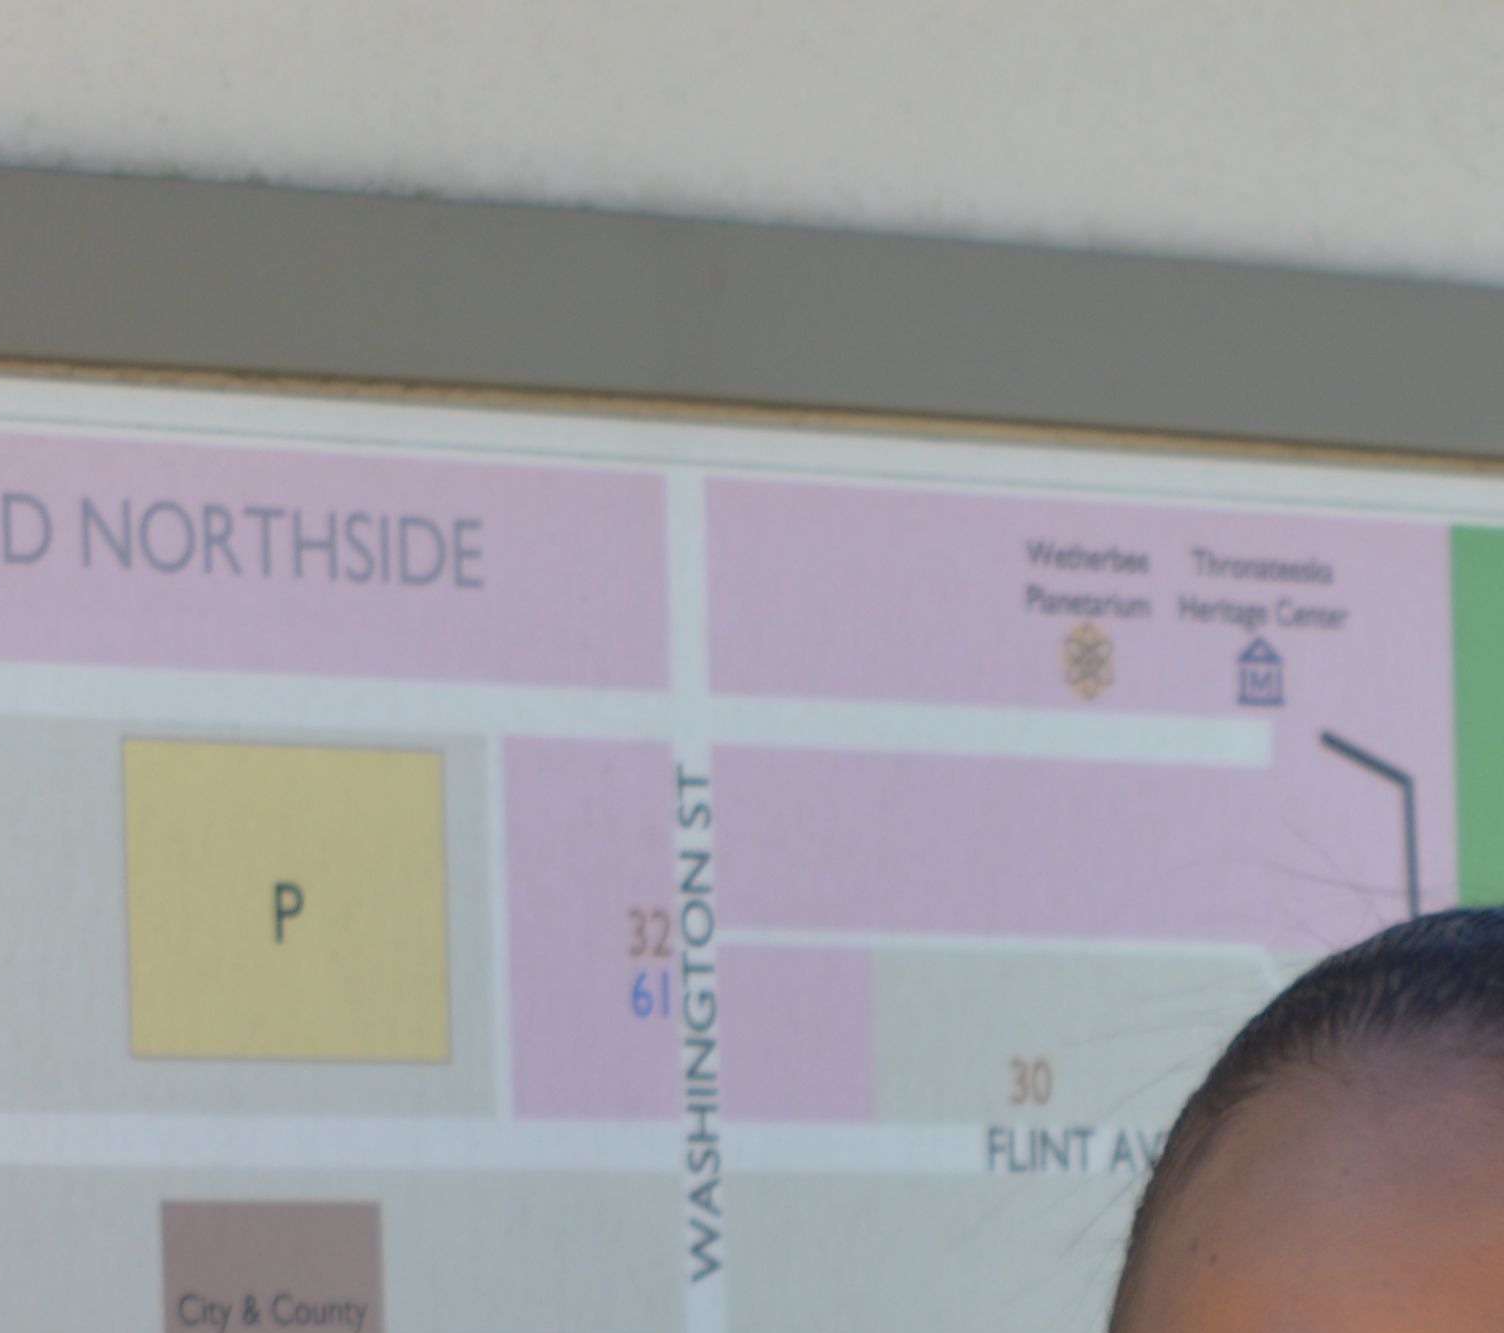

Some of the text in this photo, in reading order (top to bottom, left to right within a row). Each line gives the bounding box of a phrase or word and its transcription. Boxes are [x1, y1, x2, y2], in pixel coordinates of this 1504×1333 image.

[81, 497, 486, 591] NORTHSIDE
[1178, 595, 1348, 630] Heritage Center
[274, 882, 304, 945] P
[628, 908, 672, 959] 32
[631, 971, 671, 1019] 61
[676, 764, 723, 1283] WASHINGTON ST
[1008, 1058, 1053, 1106] 30
[987, 1126, 1094, 1174] FLINT
[178, 1292, 369, 1333] City & County
